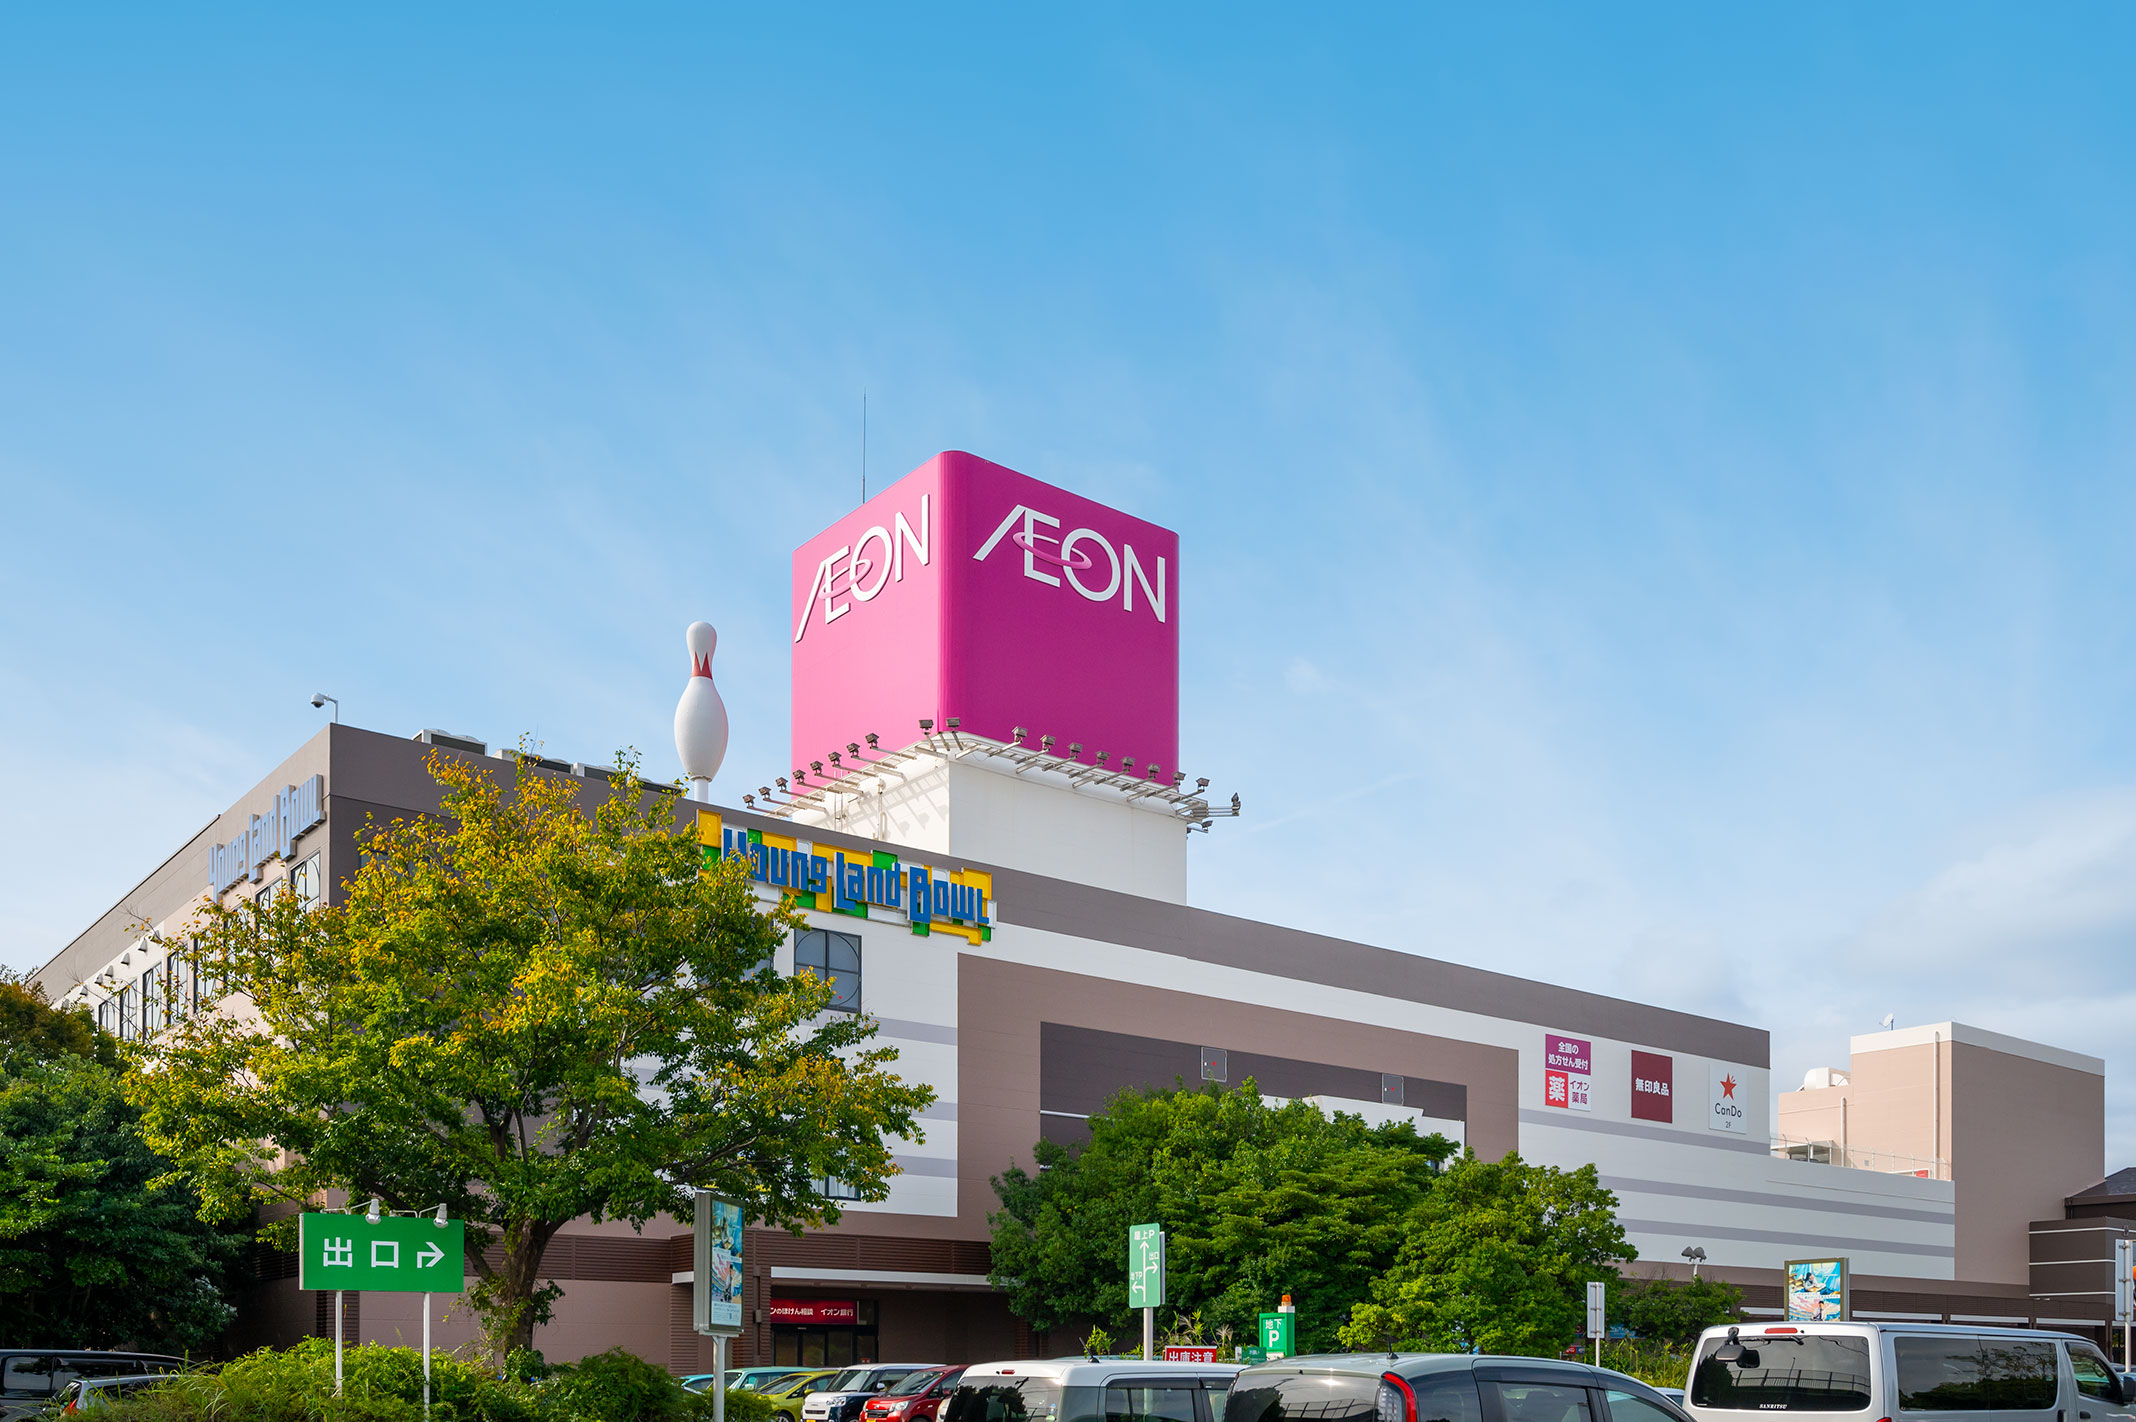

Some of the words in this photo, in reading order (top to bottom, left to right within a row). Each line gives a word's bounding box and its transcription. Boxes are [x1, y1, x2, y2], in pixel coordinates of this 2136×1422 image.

[834, 851, 901, 911] Land
[1558, 1041, 1579, 1055] 全国の
[1548, 1053, 1588, 1071] 処方せん受付
[1548, 1075, 1566, 1102] 薬
[1570, 1080, 1590, 1092] イオン
[1635, 1077, 1669, 1096] 無印良品
[1572, 1091, 1588, 1105] 薬局
[1714, 1102, 1742, 1118] CanDo
[323, 1237, 399, 1269] 出口
[1265, 1319, 1282, 1330] 地下
[1268, 1330, 1280, 1348] P
